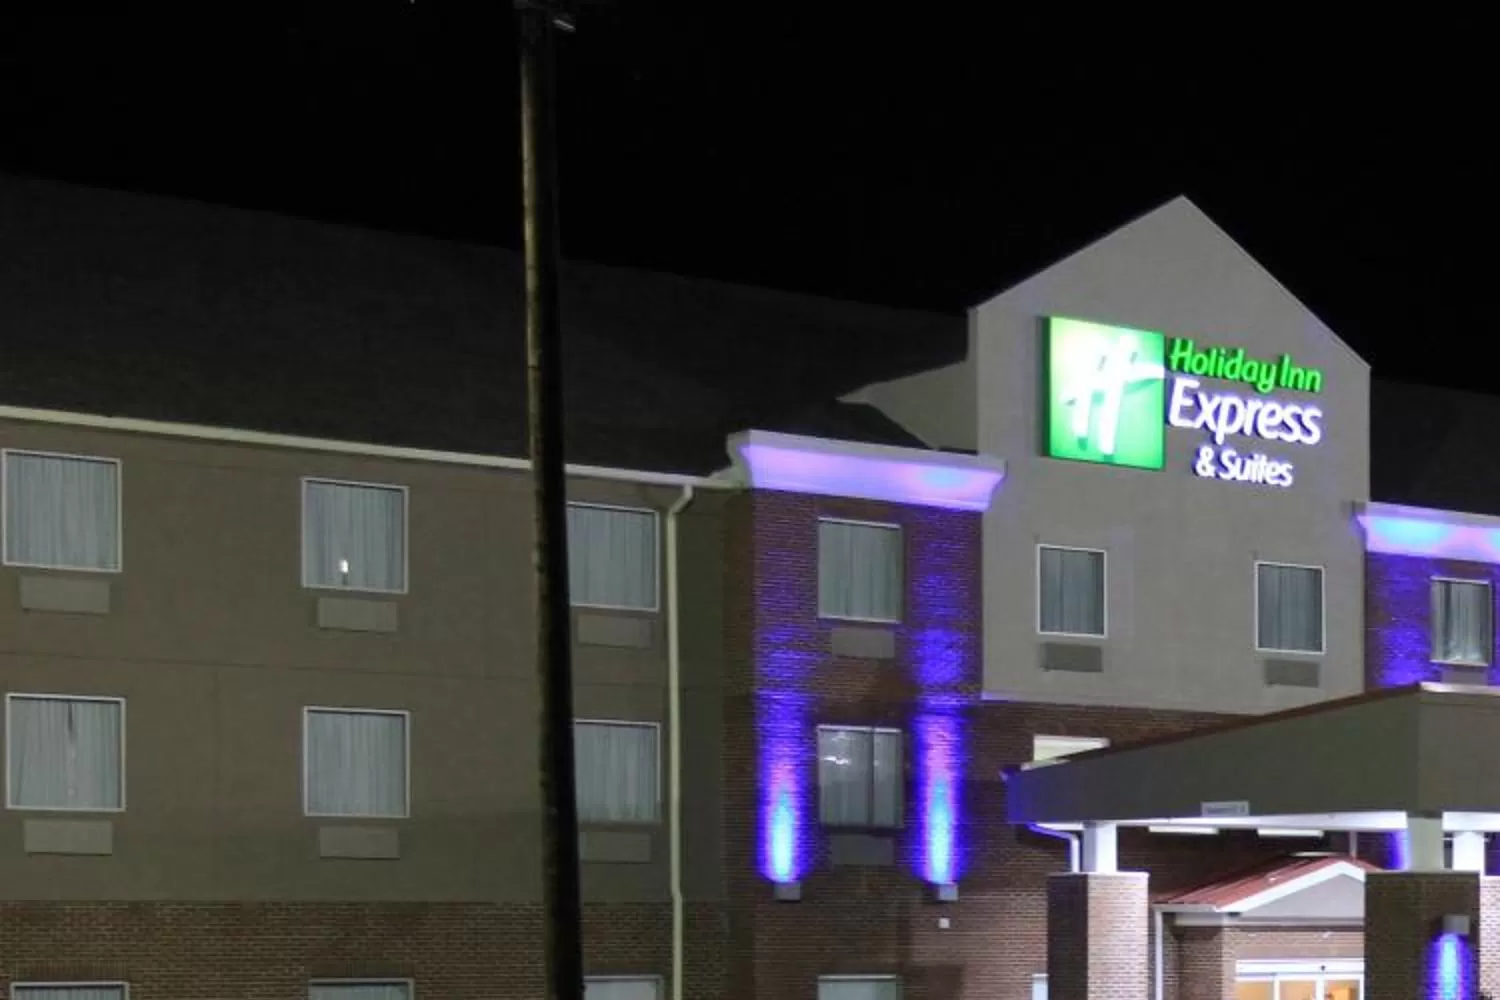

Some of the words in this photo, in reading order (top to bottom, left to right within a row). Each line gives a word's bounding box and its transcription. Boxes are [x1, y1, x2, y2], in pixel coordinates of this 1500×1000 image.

[1168, 337, 1278, 393] Holiday
[1279, 354, 1322, 392] Inn
[1167, 376, 1323, 446] Express
[1193, 446, 1214, 478] &
[1215, 451, 1294, 487] Suites
